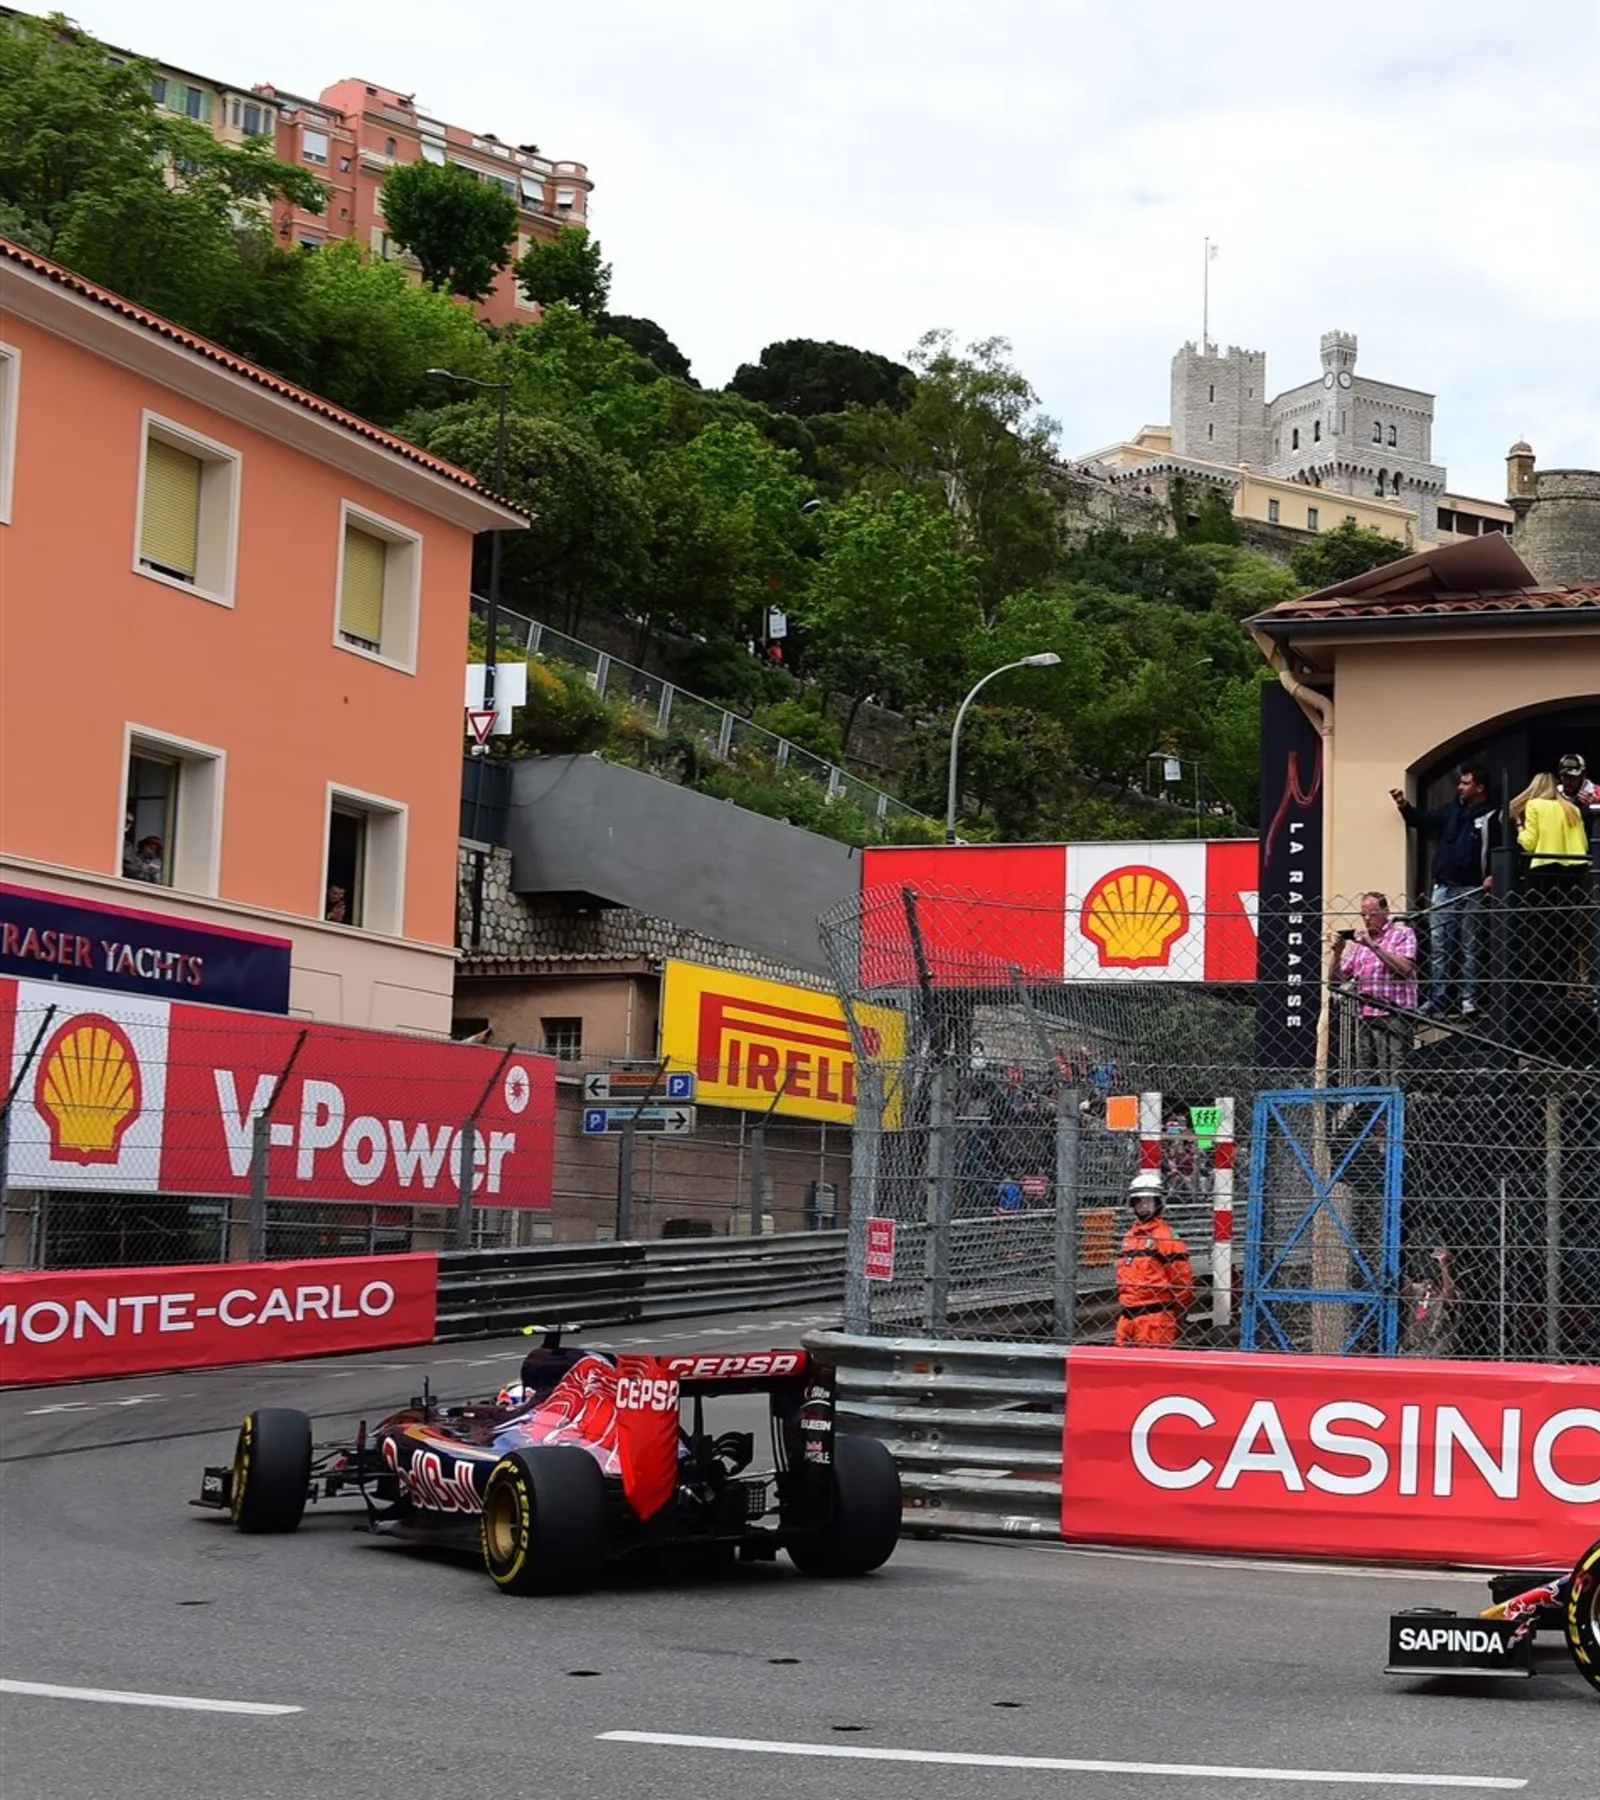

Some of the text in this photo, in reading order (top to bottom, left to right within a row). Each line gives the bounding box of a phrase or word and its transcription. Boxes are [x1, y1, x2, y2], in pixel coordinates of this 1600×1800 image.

[1286, 822, 1304, 1027] LA RASCASSE
[0, 922, 203, 986] RASER YACHTS
[213, 1067, 516, 1194] V-Power
[668, 1354, 798, 1378] CEPSA
[615, 1376, 680, 1412] CEPSA
[1399, 1628, 1504, 1654] SAPINDA
